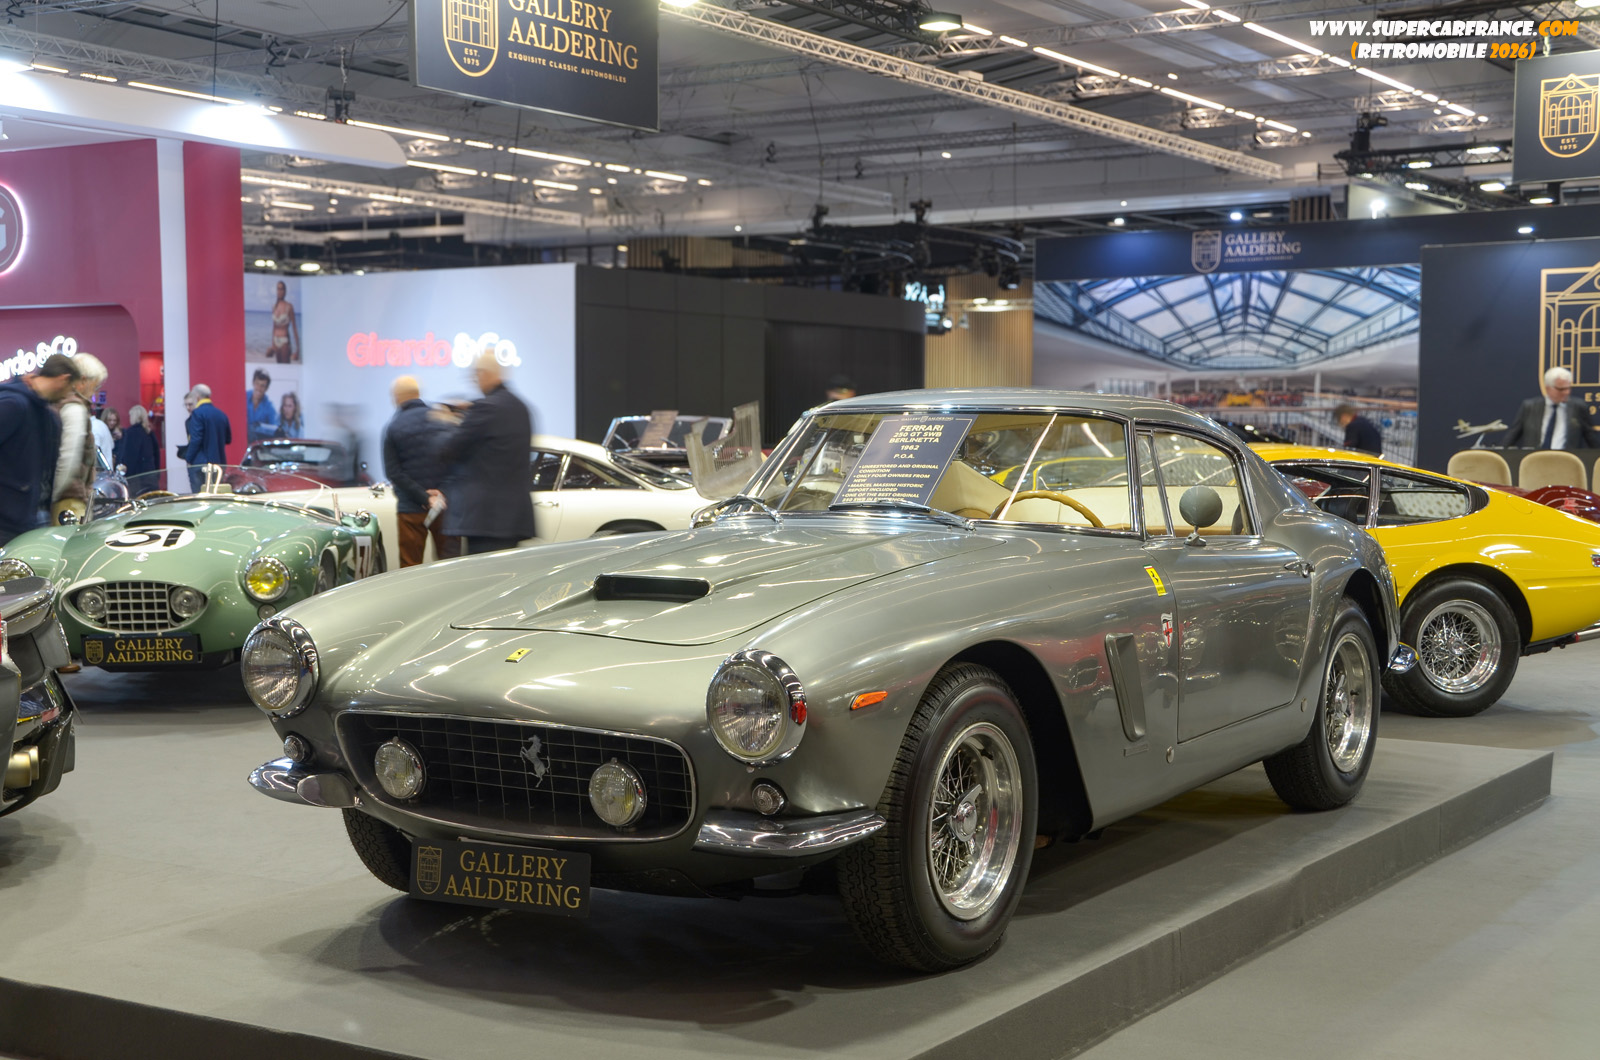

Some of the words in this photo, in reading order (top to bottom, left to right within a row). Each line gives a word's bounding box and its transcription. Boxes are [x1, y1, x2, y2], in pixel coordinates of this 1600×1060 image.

[508, 17, 639, 70] AALDERING
[464, 47, 480, 58] EST.
[463, 57, 480, 67] 1975
[508, 51, 547, 66] EXQUISITE
[549, 60, 579, 73] CLASSIC
[581, 67, 627, 84] AUTOMOBILES
[1560, 137, 1578, 145] EST.
[1224, 231, 1287, 245] GALLERY
[1224, 241, 1302, 257] AALDERING
[899, 424, 945, 432] FERRARI
[105, 528, 185, 547] 31
[115, 638, 183, 651] GALLERY
[106, 649, 194, 663] AALDERING
[459, 849, 568, 880] GALLERY
[444, 874, 581, 909] AALDERING
